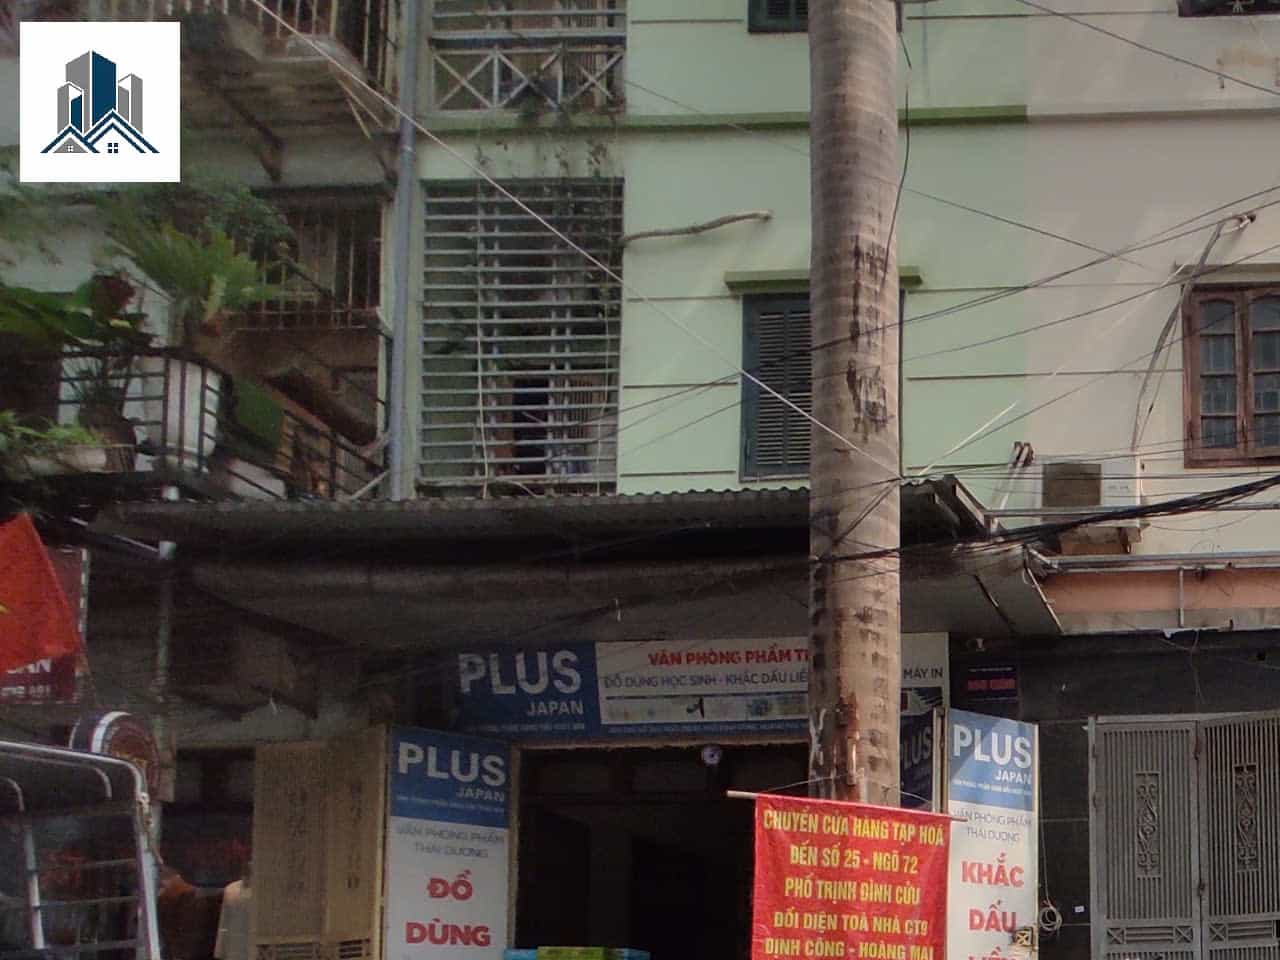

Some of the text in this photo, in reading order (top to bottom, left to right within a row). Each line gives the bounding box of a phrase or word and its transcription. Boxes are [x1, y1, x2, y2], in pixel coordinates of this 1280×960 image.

[686, 648, 741, 666] PHÒNG
[745, 643, 790, 664] PHẨM
[458, 650, 582, 695] PLUS
[931, 667, 943, 678] IN
[527, 700, 584, 716] JAPAN
[901, 726, 932, 770] LUS
[953, 723, 1032, 769] PLUS
[398, 741, 506, 787] PLUS
[994, 770, 1032, 785] JAPAN
[456, 787, 505, 803] JAPAN
[763, 805, 945, 846] CHUYỂN CỬA HÀNG TẠP HOÁ
[789, 840, 818, 866] ĐẾN
[822, 841, 841, 867] SỐ
[844, 850, 860, 869] 25
[872, 849, 899, 872] NGÕ
[903, 855, 918, 874] 72
[961, 853, 1025, 887] KHẮC
[426, 869, 473, 901] ĐỒ
[784, 872, 815, 899] PHỐ
[817, 880, 857, 904] TRỊNH
[860, 879, 892, 903] ĐÌNH
[774, 906, 799, 929] ĐỐI
[803, 912, 837, 934] DIỆN
[873, 912, 901, 934] NHÀ
[904, 919, 928, 936] CT9
[968, 899, 1017, 933] DẤU
[405, 918, 491, 947] DÙNG
[764, 938, 800, 959] ĐỊNH
[804, 937, 845, 957] CÔNG
[859, 941, 906, 960] HOÀNG
